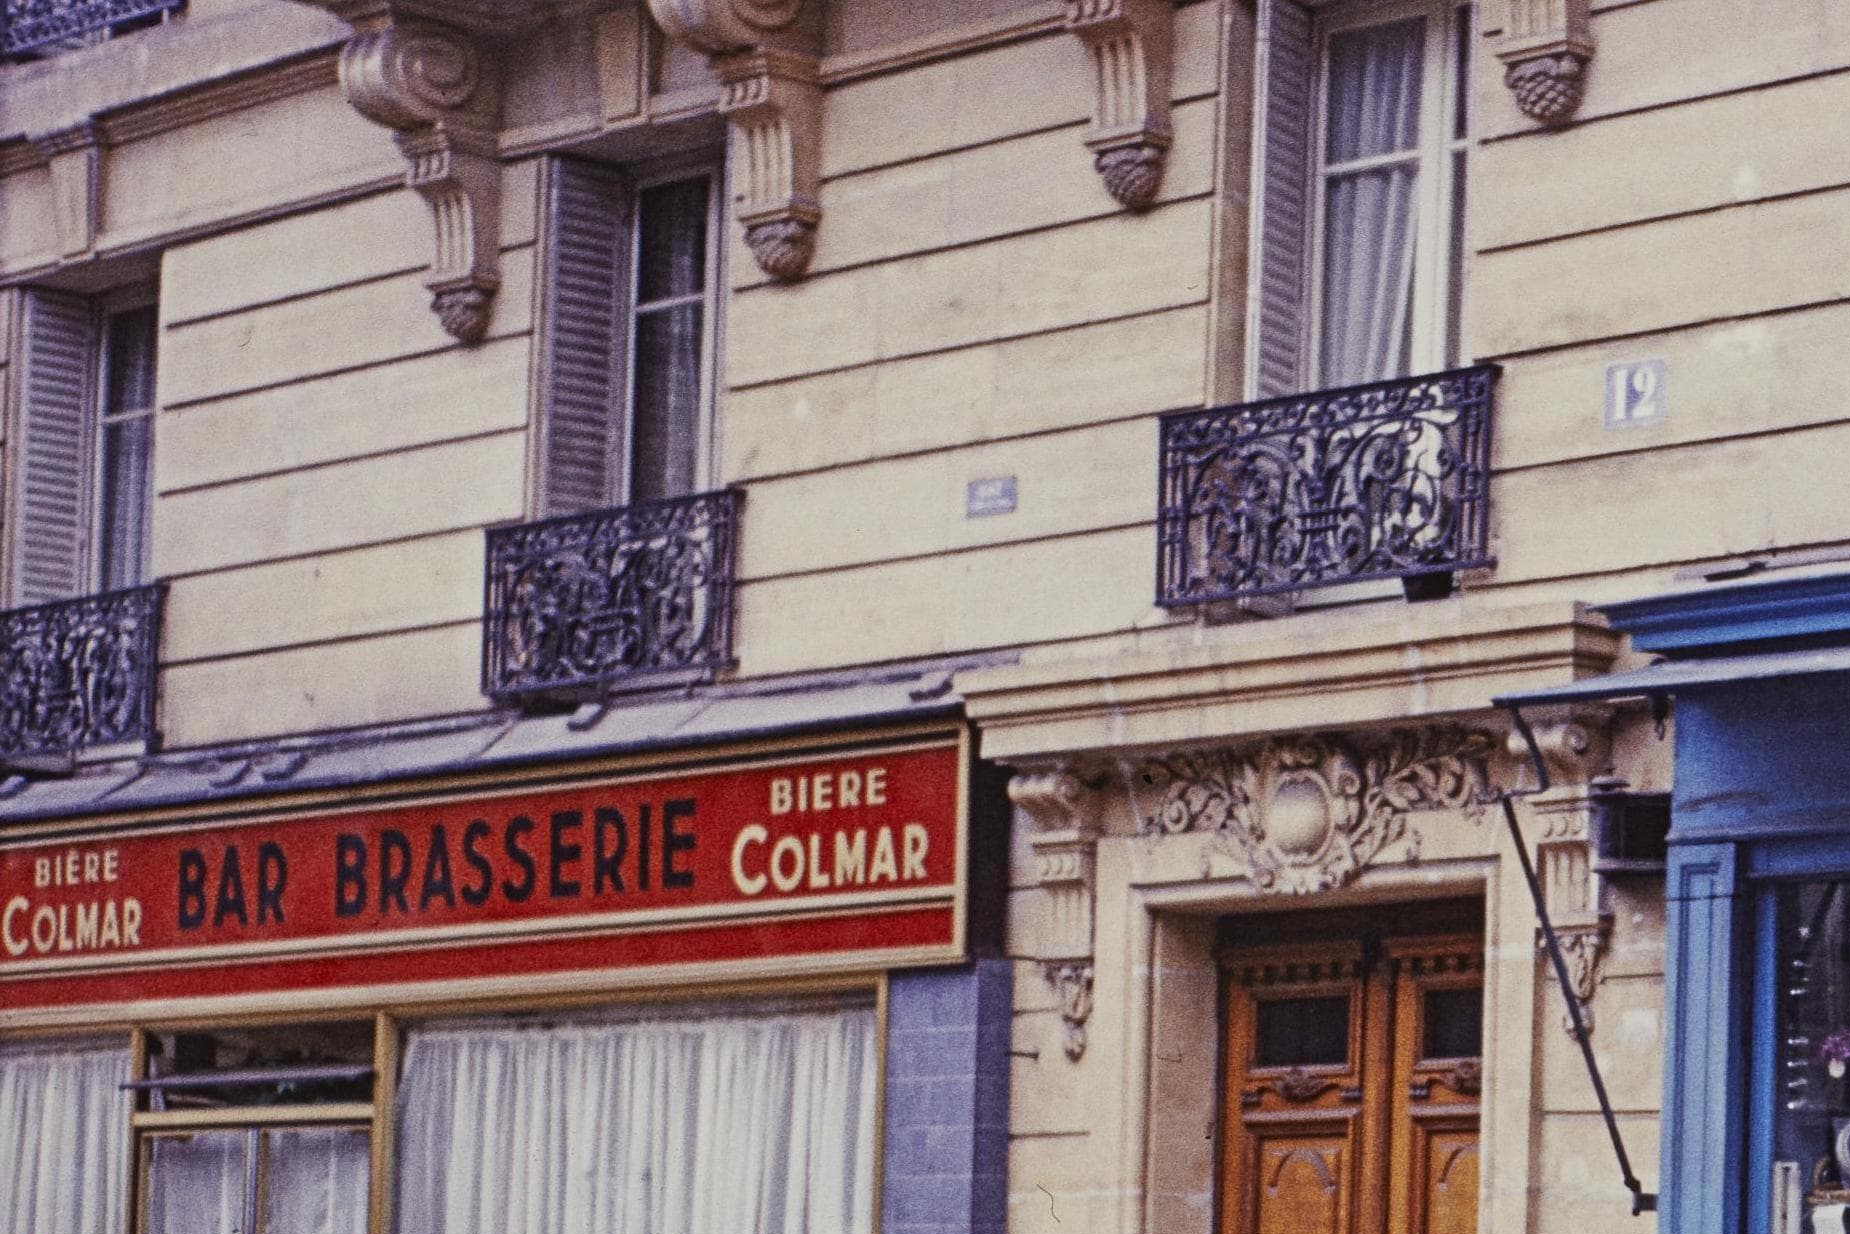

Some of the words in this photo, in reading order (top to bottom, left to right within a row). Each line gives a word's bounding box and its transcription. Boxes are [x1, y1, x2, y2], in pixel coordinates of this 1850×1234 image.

[1614, 367, 1657, 420] 12
[178, 840, 287, 930] BAR
[335, 797, 697, 918] BRASSERIE
